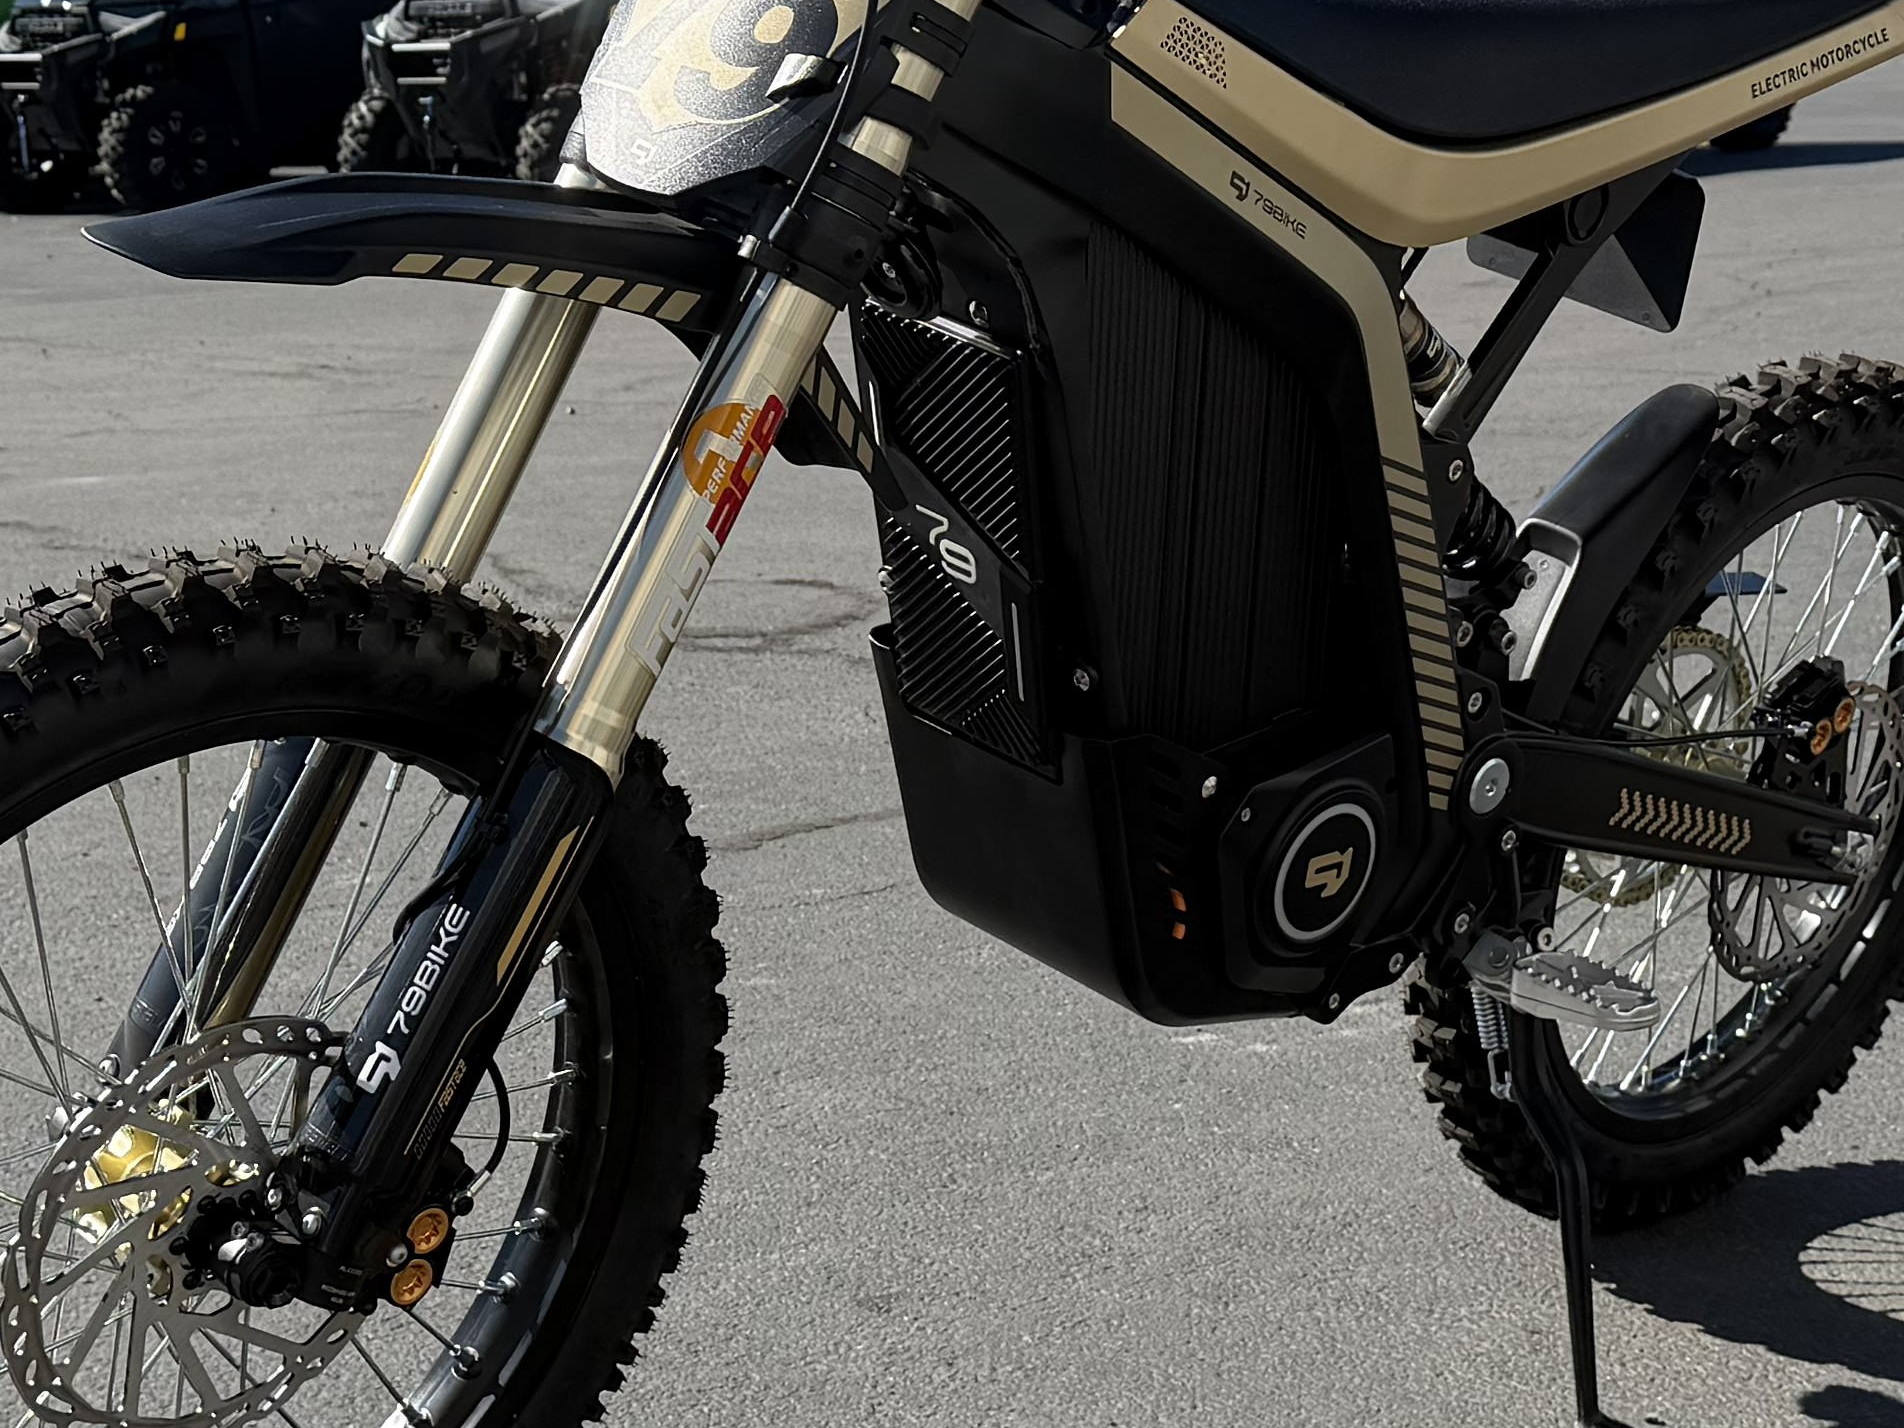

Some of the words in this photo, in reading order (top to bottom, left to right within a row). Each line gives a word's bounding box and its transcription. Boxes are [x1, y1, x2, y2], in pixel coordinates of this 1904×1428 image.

[1750, 62, 1809, 99] ELECTRIC
[1810, 27, 1890, 74] MOTORCYCLE
[1253, 189, 1307, 240] 79BIKE
[915, 504, 977, 585] 79
[387, 903, 471, 1035] 79BIKE
